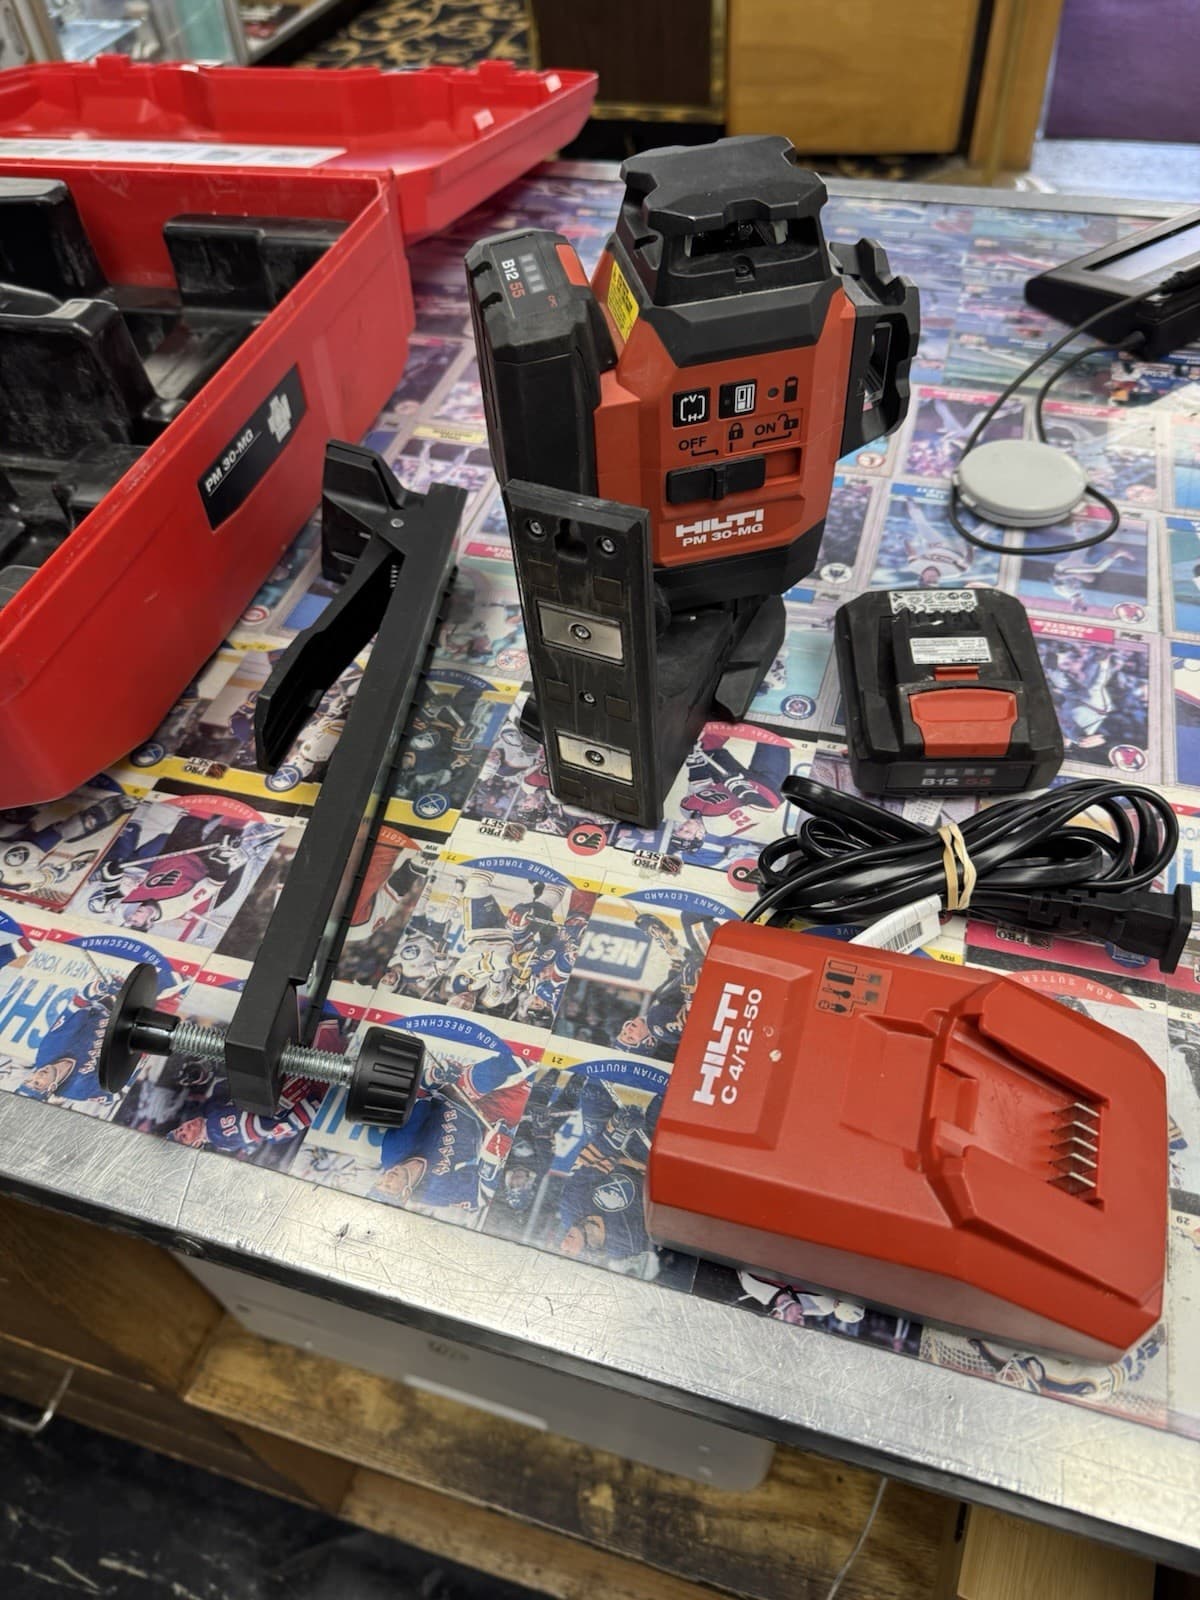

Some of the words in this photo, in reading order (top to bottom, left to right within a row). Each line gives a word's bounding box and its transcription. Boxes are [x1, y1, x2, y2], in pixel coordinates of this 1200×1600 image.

[501, 259, 519, 281] B12
[754, 422, 776, 436] ON
[678, 436, 707, 451] OFF
[205, 466, 223, 493] PM
[222, 429, 254, 471] 30-MG
[675, 508, 764, 537] HILTI
[682, 534, 707, 547] PM
[711, 523, 763, 541] 30-MG
[921, 777, 959, 786] B12
[481, 818, 506, 828] SET
[479, 827, 502, 837] PRO
[635, 850, 661, 861] SET
[478, 858, 524, 869] TURGEON
[633, 859, 658, 871] PRO
[528, 863, 560, 883] PIERRE
[643, 892, 689, 902] LEDYARD
[693, 897, 726, 915] GRANT
[997, 930, 1025, 944] PRO
[81, 939, 141, 956] GRESCHNER
[1085, 983, 1114, 1001] RON
[1149, 1002, 1157, 1010] C
[375, 1012, 382, 1020] 4
[405, 1018, 473, 1035] GRESCHNER
[476, 1030, 499, 1049] RON
[728, 988, 763, 1081] 4/12-50
[692, 982, 746, 1106] HILTI
[521, 1048, 531, 1056] D
[551, 1056, 564, 1065] 21
[585, 1063, 628, 1074] RUUTTU
[721, 1085, 738, 1105] C
